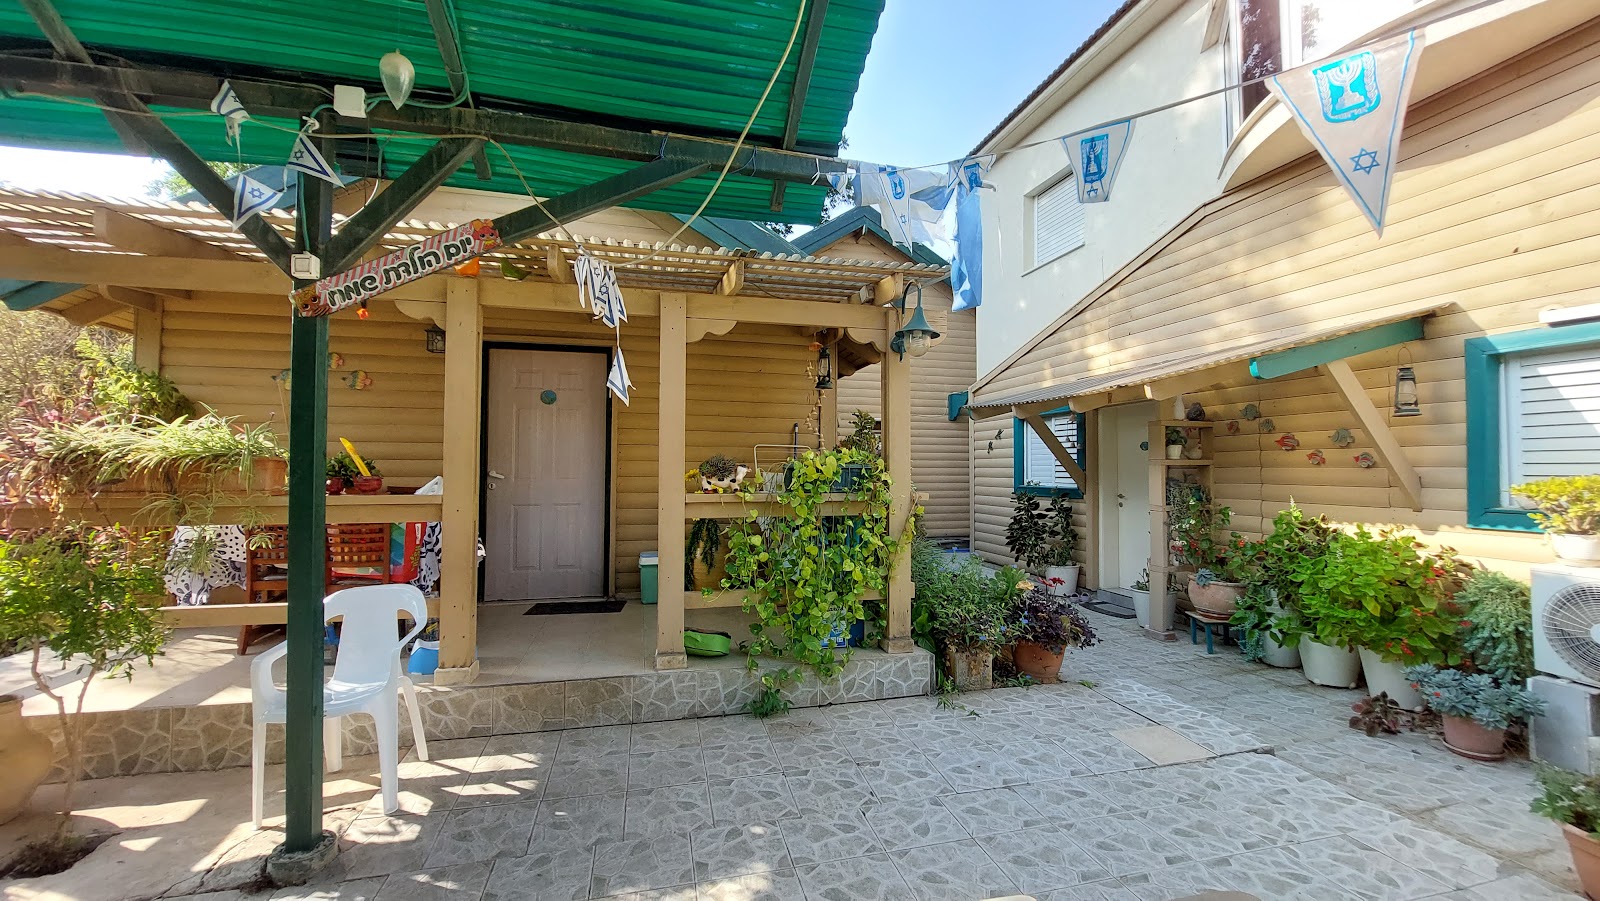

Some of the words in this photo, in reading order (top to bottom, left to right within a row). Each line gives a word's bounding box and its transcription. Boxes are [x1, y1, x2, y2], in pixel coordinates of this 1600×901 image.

[382, 245, 442, 287] הולדת
[443, 236, 473, 262] יום
[326, 273, 378, 308] שמח
